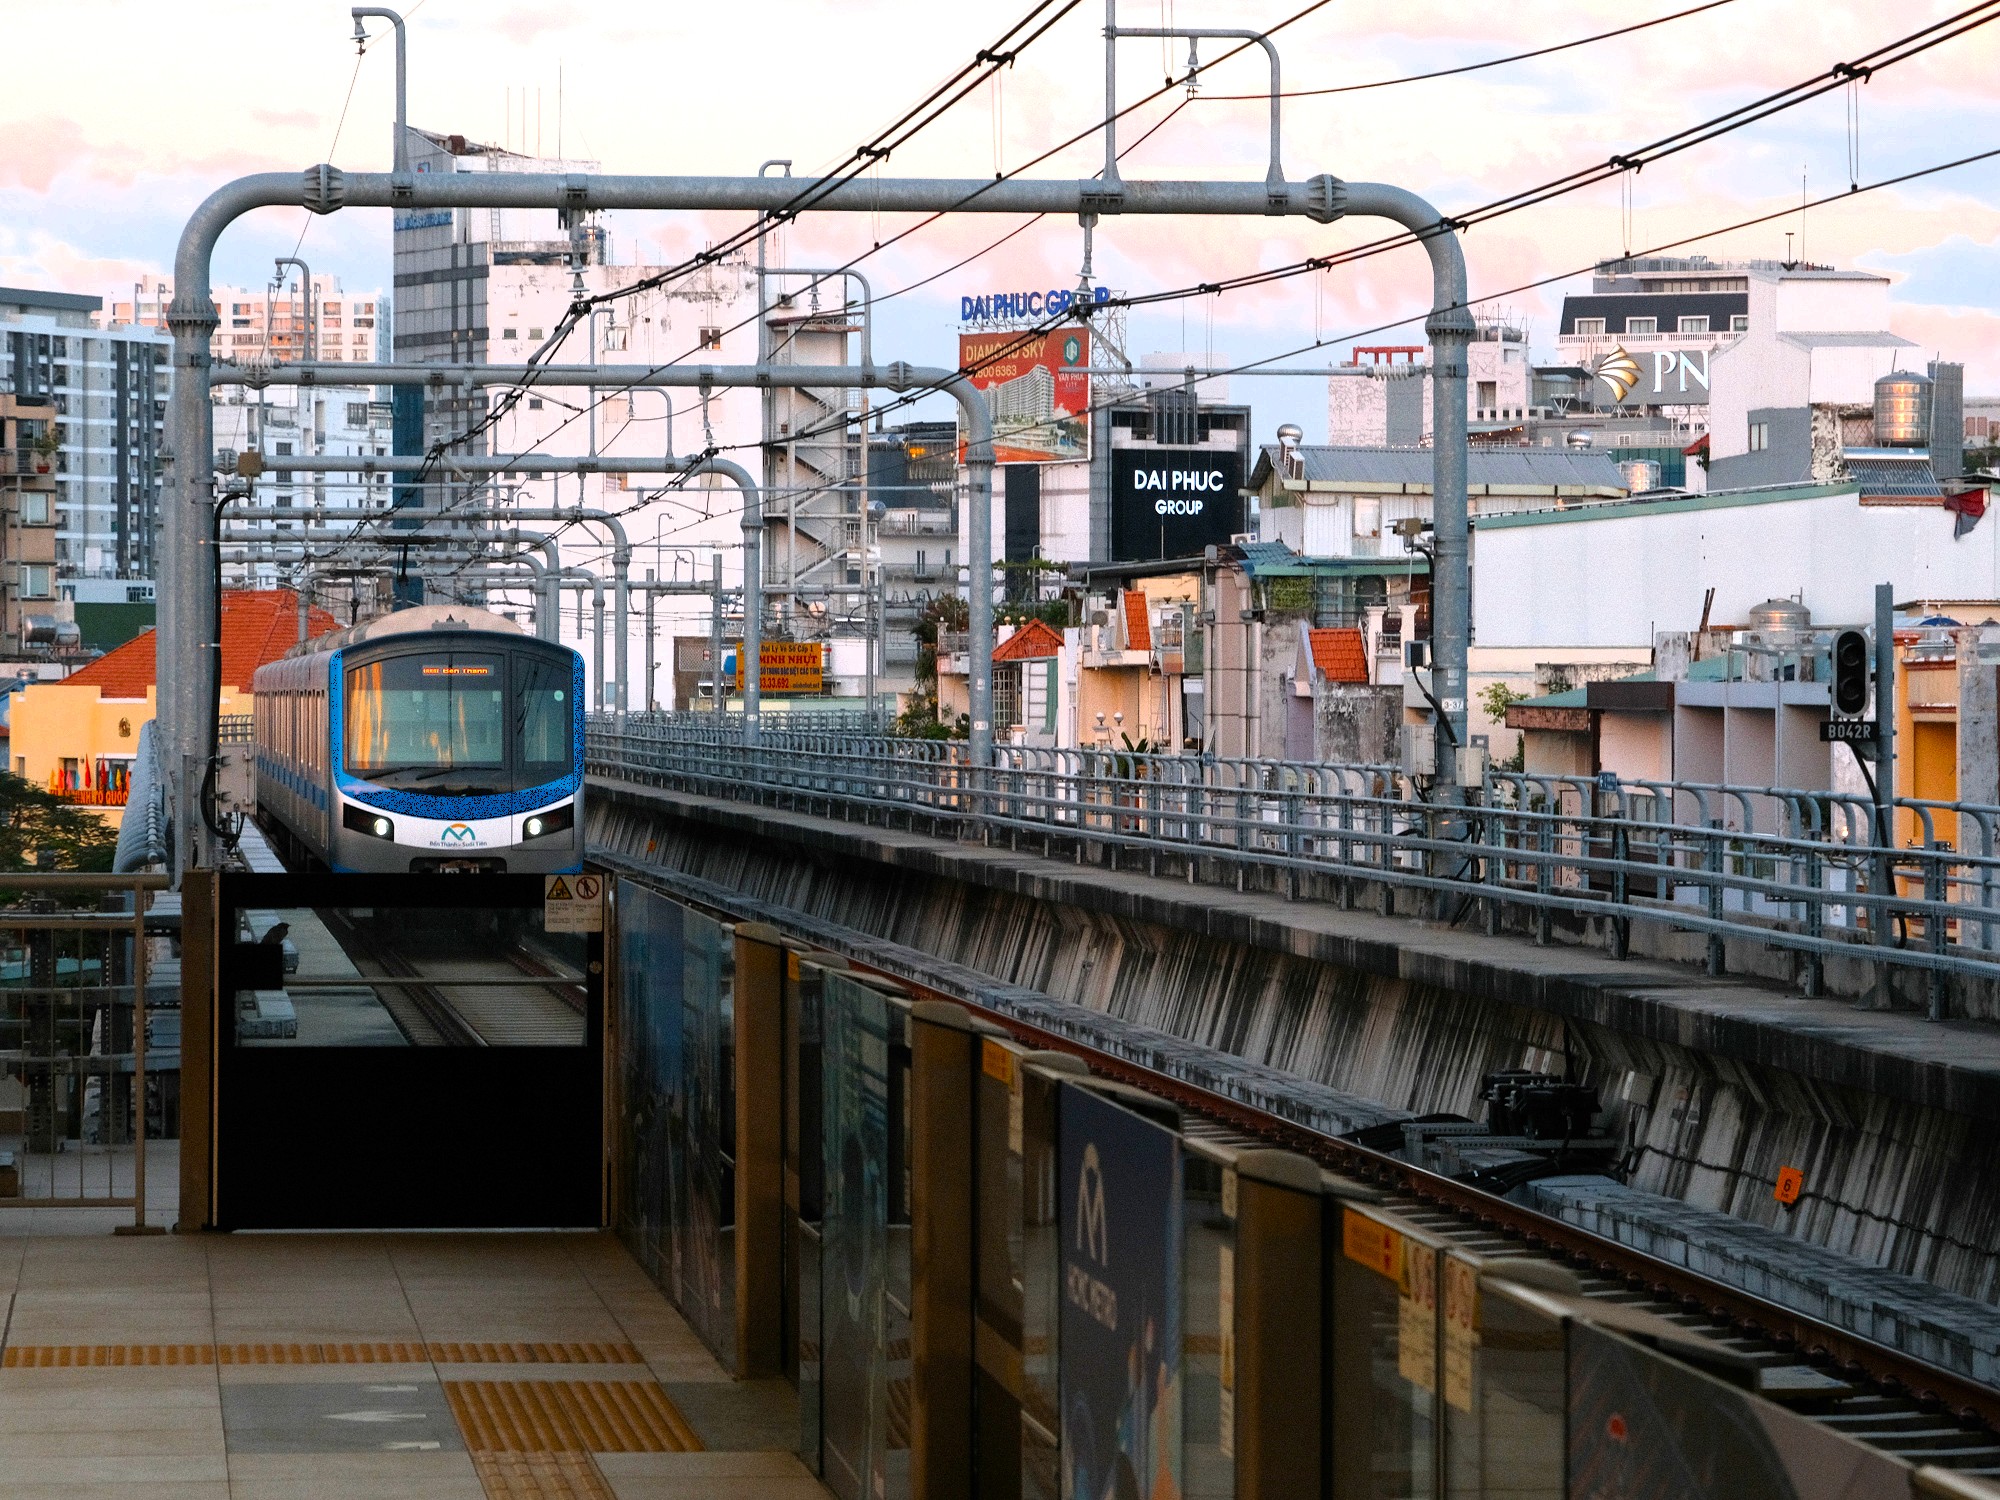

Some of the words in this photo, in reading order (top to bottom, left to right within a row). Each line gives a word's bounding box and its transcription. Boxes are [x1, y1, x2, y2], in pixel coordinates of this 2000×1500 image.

[962, 295, 990, 321] DAI
[993, 291, 1043, 318] PHUC
[1022, 340, 1046, 359] SKY
[995, 364, 1017, 377] 6363
[1134, 469, 1167, 490] DAI
[1171, 470, 1224, 491] PHUC
[1155, 499, 1203, 515] GROUP
[759, 655, 785, 664] MINH
